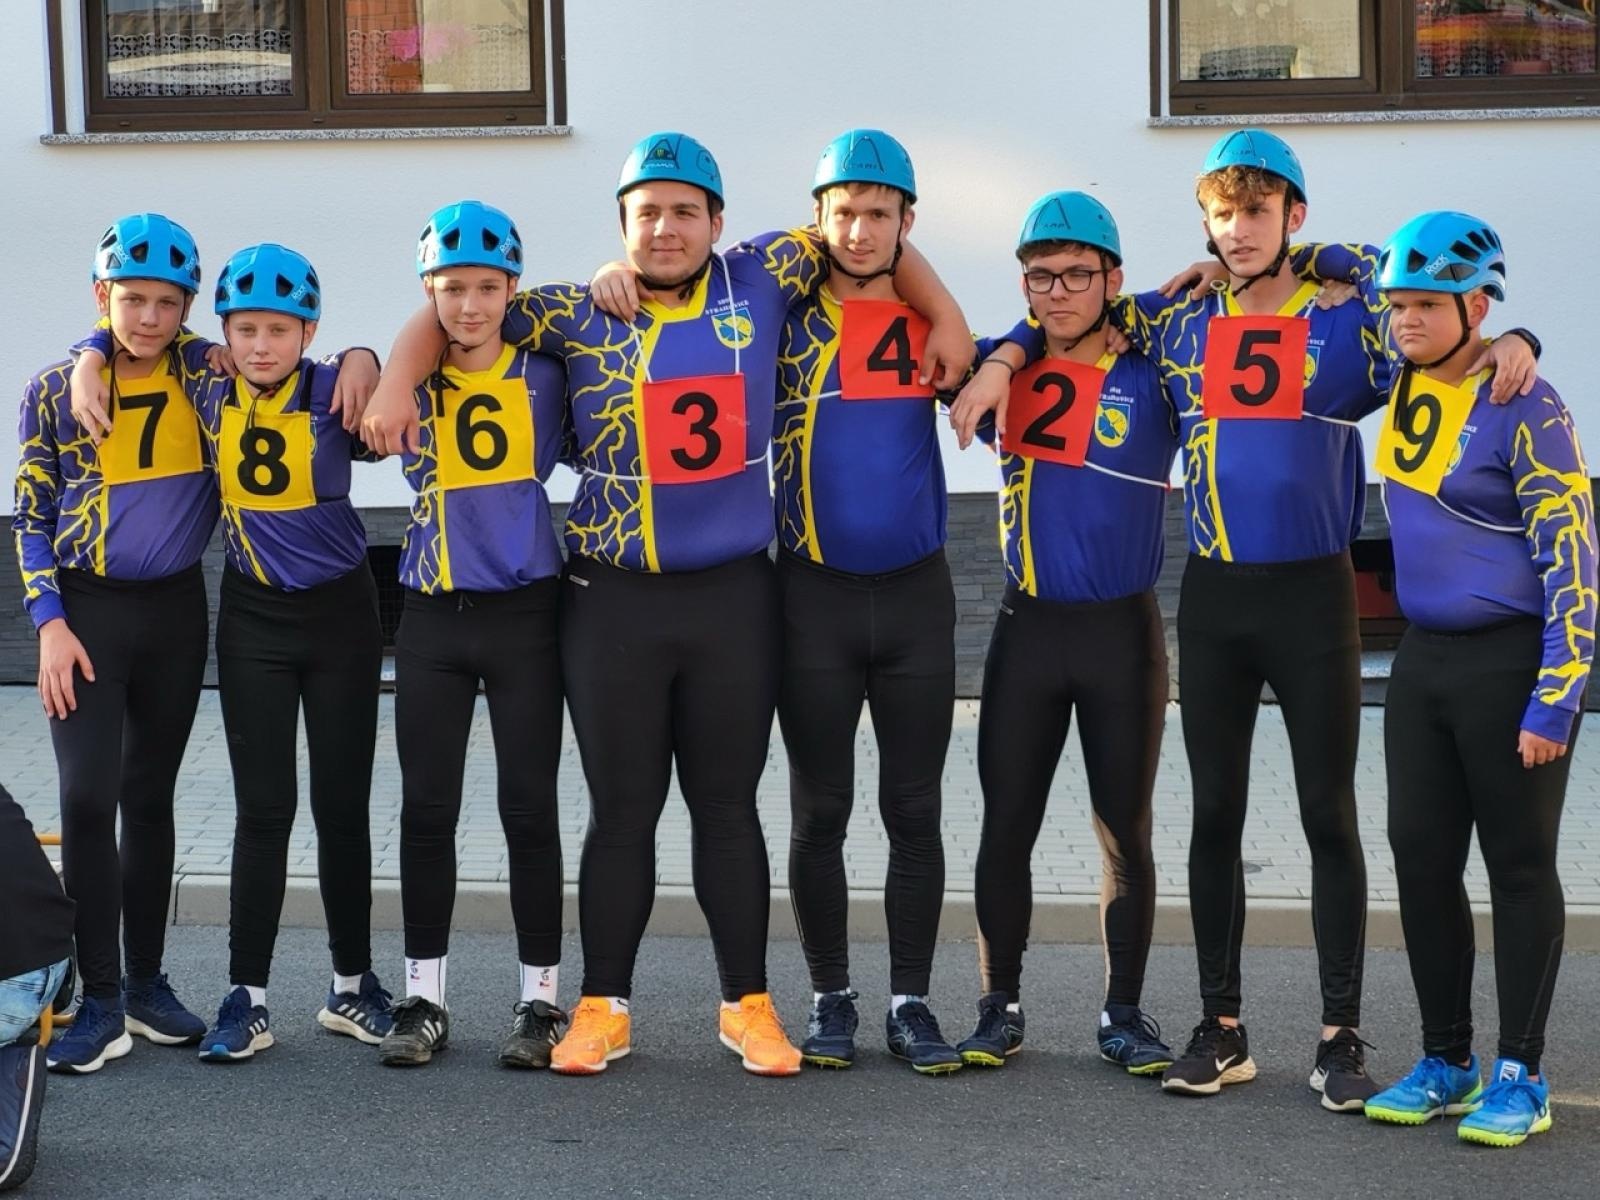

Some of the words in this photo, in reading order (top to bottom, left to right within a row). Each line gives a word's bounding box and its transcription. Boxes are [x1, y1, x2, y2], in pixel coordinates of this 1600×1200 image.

[867, 316, 918, 386] 4
[1231, 330, 1281, 406] 5
[119, 391, 169, 469] 7
[456, 394, 508, 471] 6
[671, 392, 721, 471] 3
[1021, 372, 1076, 451] 2
[1394, 393, 1442, 473] 9
[237, 427, 291, 496] 8
